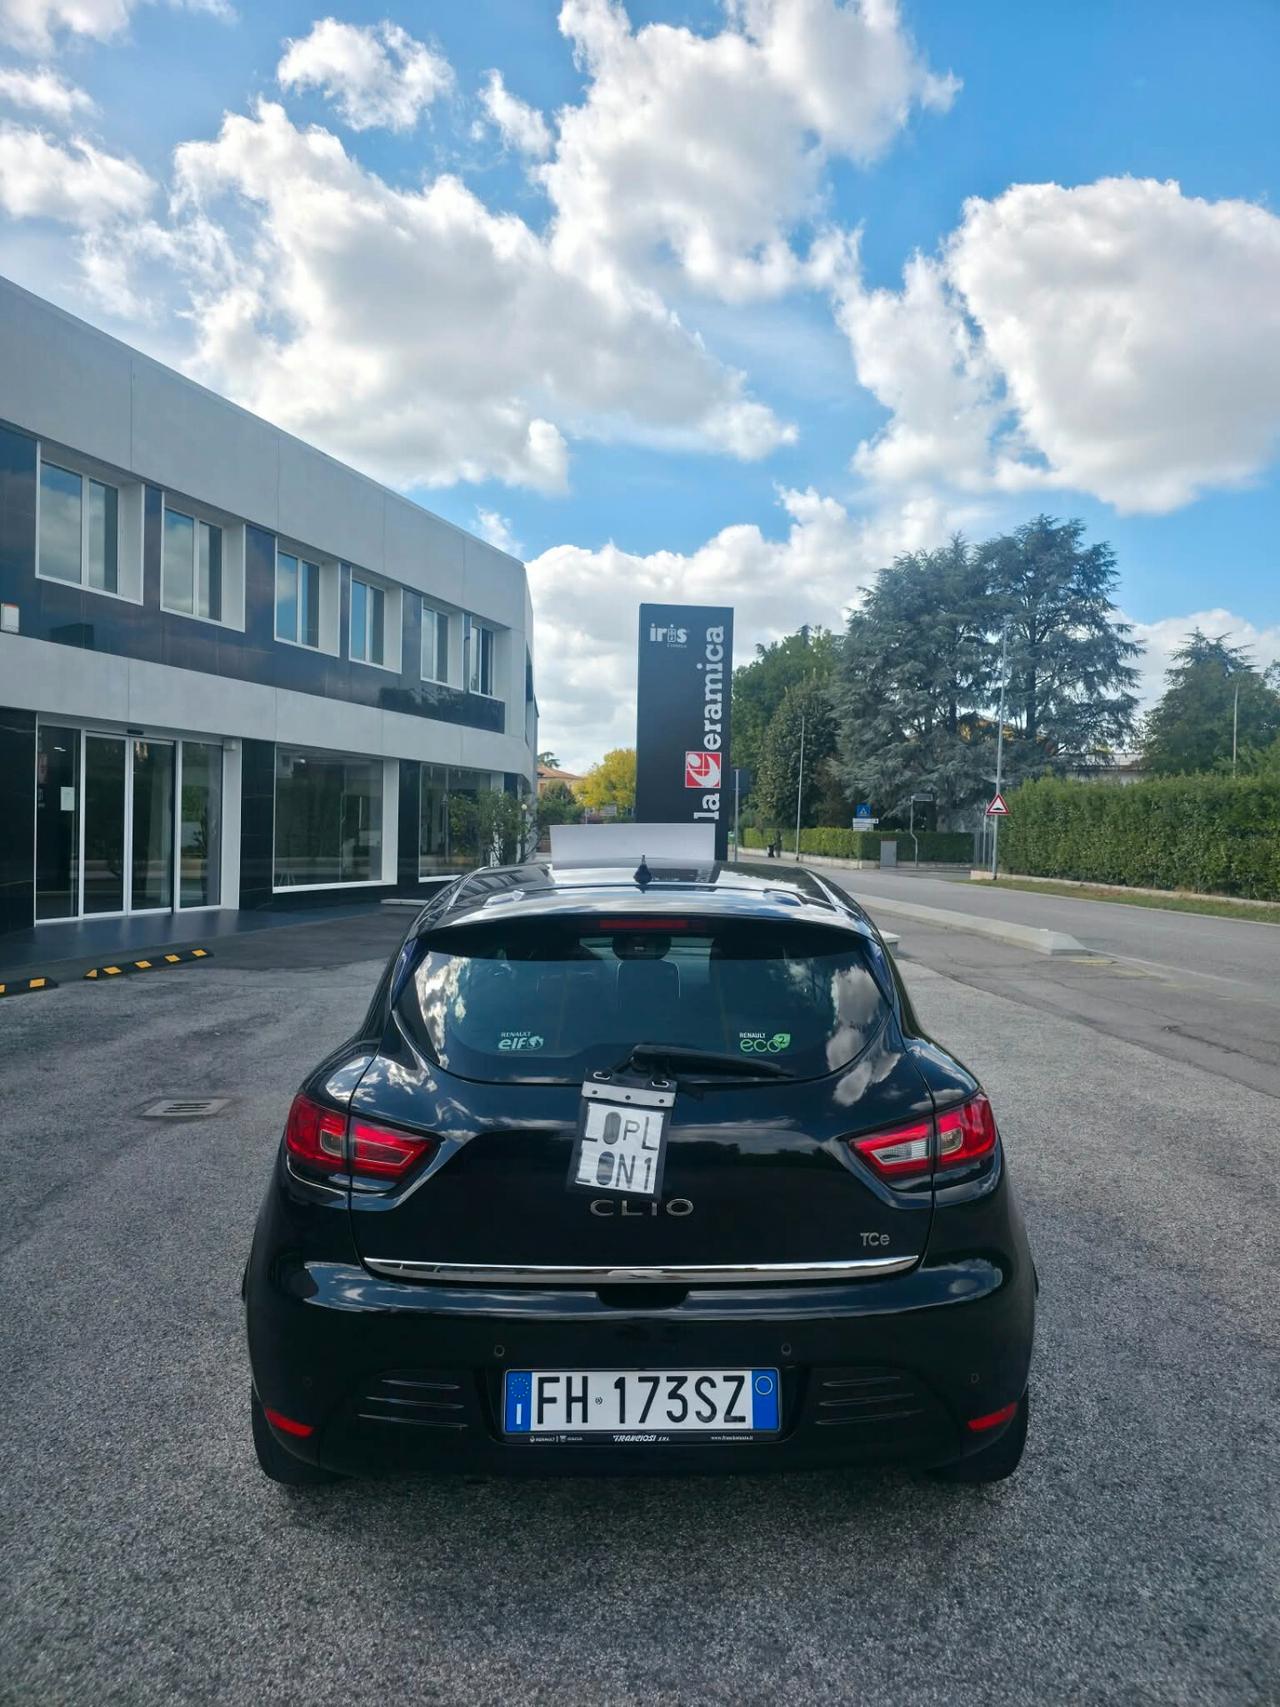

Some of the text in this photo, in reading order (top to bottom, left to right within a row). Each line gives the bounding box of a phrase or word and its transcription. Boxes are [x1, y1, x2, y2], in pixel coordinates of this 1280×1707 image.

[650, 622, 688, 643] iris
[694, 793, 720, 821] la
[590, 1199, 694, 1216] CLIO
[860, 1232, 890, 1246] TCe
